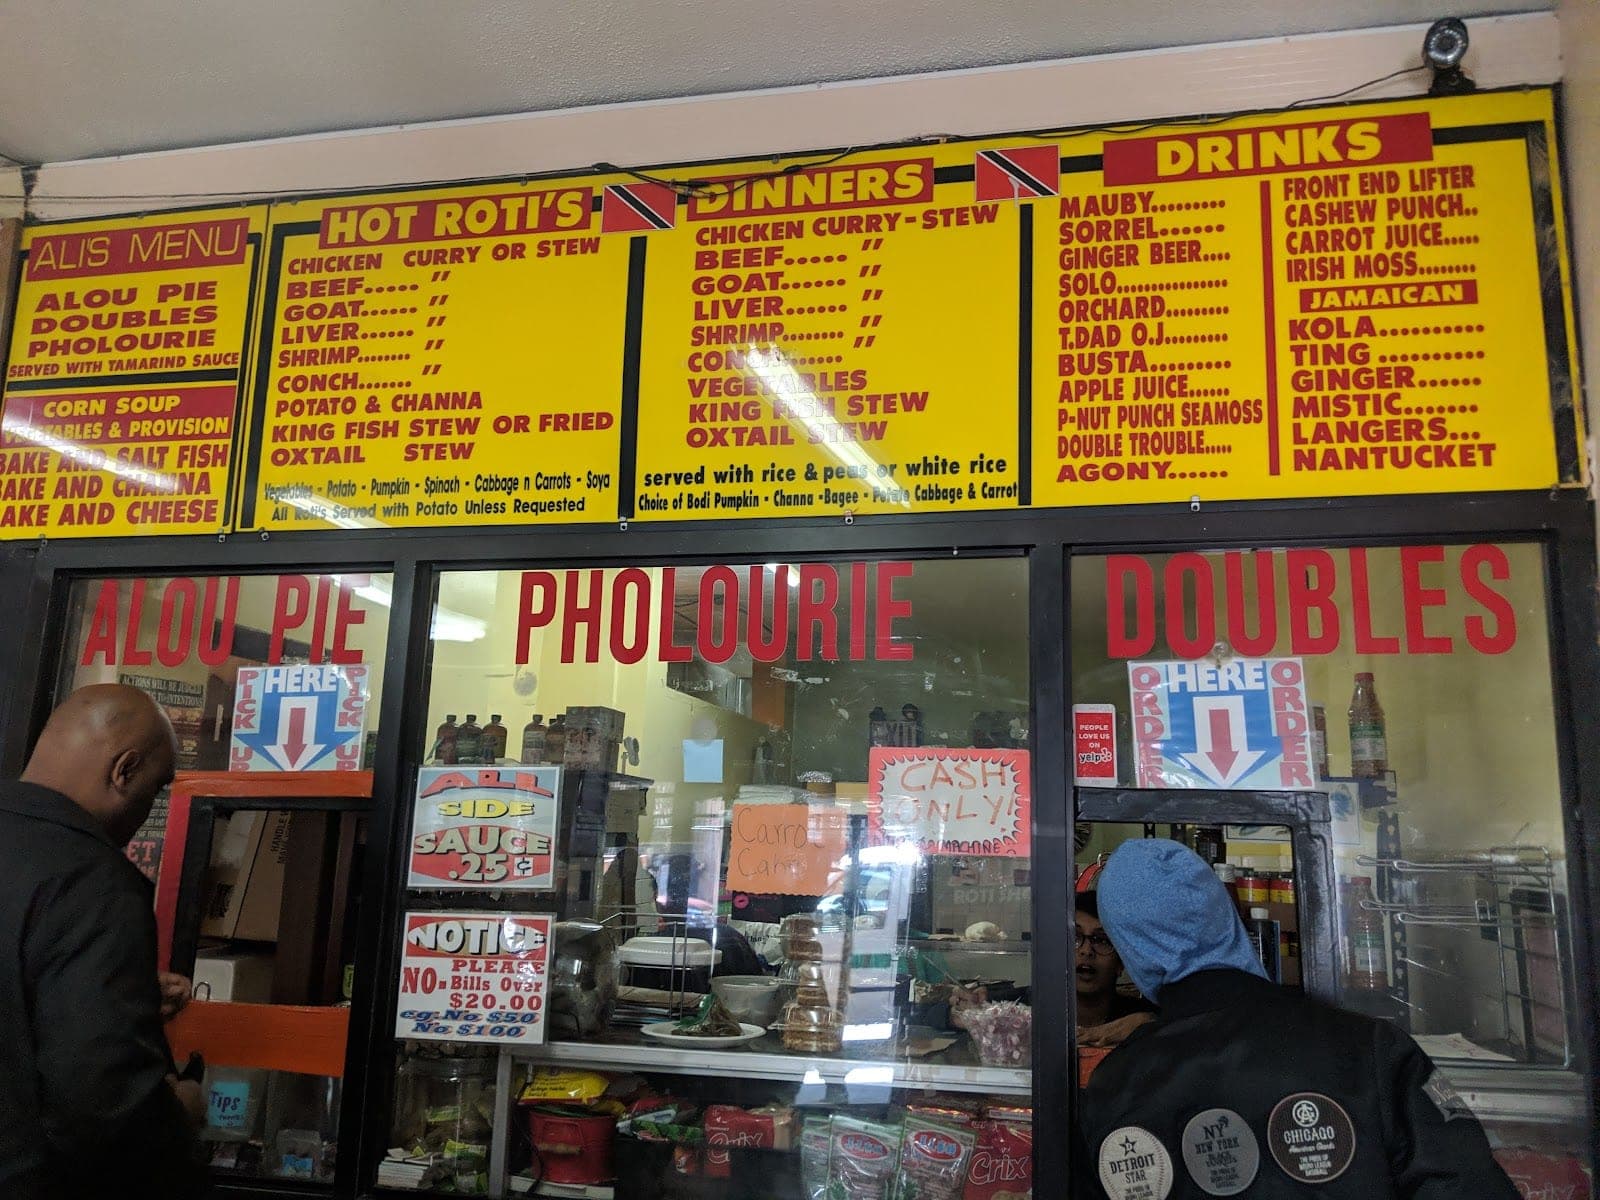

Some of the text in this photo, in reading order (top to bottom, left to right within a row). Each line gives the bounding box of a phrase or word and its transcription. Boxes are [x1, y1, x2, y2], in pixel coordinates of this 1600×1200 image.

[1156, 121, 1382, 177] DRINKS
[695, 163, 925, 214] DINNERS
[1283, 164, 1476, 202] FRONT END LIFTER
[326, 191, 584, 245] HOT ROTI'S
[1285, 201, 1378, 228] CASHEW
[129, 224, 241, 264] MENU
[695, 219, 805, 247] CHICKEN
[1285, 228, 1376, 256] CARROT
[287, 237, 601, 276] CHICKEN CURRY OR STEW
[1059, 246, 1140, 271] GINGER
[1286, 256, 1346, 283] IRISH
[35, 281, 218, 312] ALOU PIE
[1309, 283, 1464, 312] JAMAICAN
[30, 305, 218, 335] DOUBLES
[27, 329, 217, 358] PHOLOURIE
[1058, 325, 1121, 351] T.DAD
[8, 352, 239, 378] SERVED WITH TAMARIND SAUCE
[688, 369, 867, 398] VEGETABLES
[1058, 378, 1125, 403] APPLE
[43, 395, 181, 418] CORN SOUP
[275, 391, 483, 418] POTATO & CHANNA
[689, 401, 761, 423] KING
[846, 392, 929, 417] STEW
[1058, 399, 1263, 431] P-NUT PUNCH SEAMOSS
[108, 416, 230, 438] & PROVISION
[271, 411, 615, 443] KING FISH STEW OR FRIED
[686, 420, 888, 448] OXTAIL STEW
[117, 445, 169, 470] SALT
[177, 443, 229, 468] FISH
[270, 442, 476, 468] OXTAIL STEW
[1057, 433, 1123, 459] DOUBLE
[1292, 443, 1497, 472] NANTUCKET
[644, 466, 705, 486] served
[713, 464, 753, 484] with
[762, 462, 796, 482] rice
[804, 462, 818, 481] &
[906, 455, 960, 476] white
[969, 453, 1007, 474] rice
[53, 475, 104, 499] AND
[112, 472, 211, 497] CHANNA
[327, 479, 358, 498] Potato
[370, 477, 410, 499] Pumpkin
[424, 475, 461, 495] Spinach
[474, 473, 520, 496] Cabbage
[534, 471, 571, 490] Carrots
[586, 470, 611, 490] Soya
[638, 493, 669, 511] Choice
[672, 492, 684, 509] of
[687, 490, 710, 509] Bodi
[714, 490, 759, 511] Pumpkin
[773, 489, 814, 507] Channa
[914, 484, 963, 504] Cabbage
[968, 482, 976, 499] &
[0, 499, 219, 528] AKE AND CHEESE
[271, 507, 288, 521] All
[332, 503, 377, 519] Served
[382, 501, 409, 517] with
[416, 499, 459, 516] Potato
[464, 498, 507, 514] Unless
[513, 496, 587, 516] Requested
[515, 561, 914, 665] PHOLOURIE
[1105, 544, 1518, 659] DOUBLES
[80, 573, 370, 668] ALOU PIE
[264, 665, 338, 694] HERE
[1165, 660, 1266, 694] HERE
[1270, 661, 1314, 787] ORDER
[1079, 751, 1101, 764] yelp
[420, 769, 554, 799] ALL
[901, 760, 1006, 792] CASH
[437, 799, 535, 818] SIDE
[415, 825, 552, 855] SAUCE
[408, 919, 547, 956] NOTICE
[451, 960, 545, 974] PLEASE
[450, 975, 490, 991] Bills
[449, 992, 543, 1010] $20.00
[209, 1091, 241, 1113] Tips
[1283, 1126, 1335, 1145] CHICAGO
[968, 1152, 1031, 1185] Crix
[1109, 1153, 1155, 1174] DETROIT
[1125, 1170, 1147, 1184] STAR
